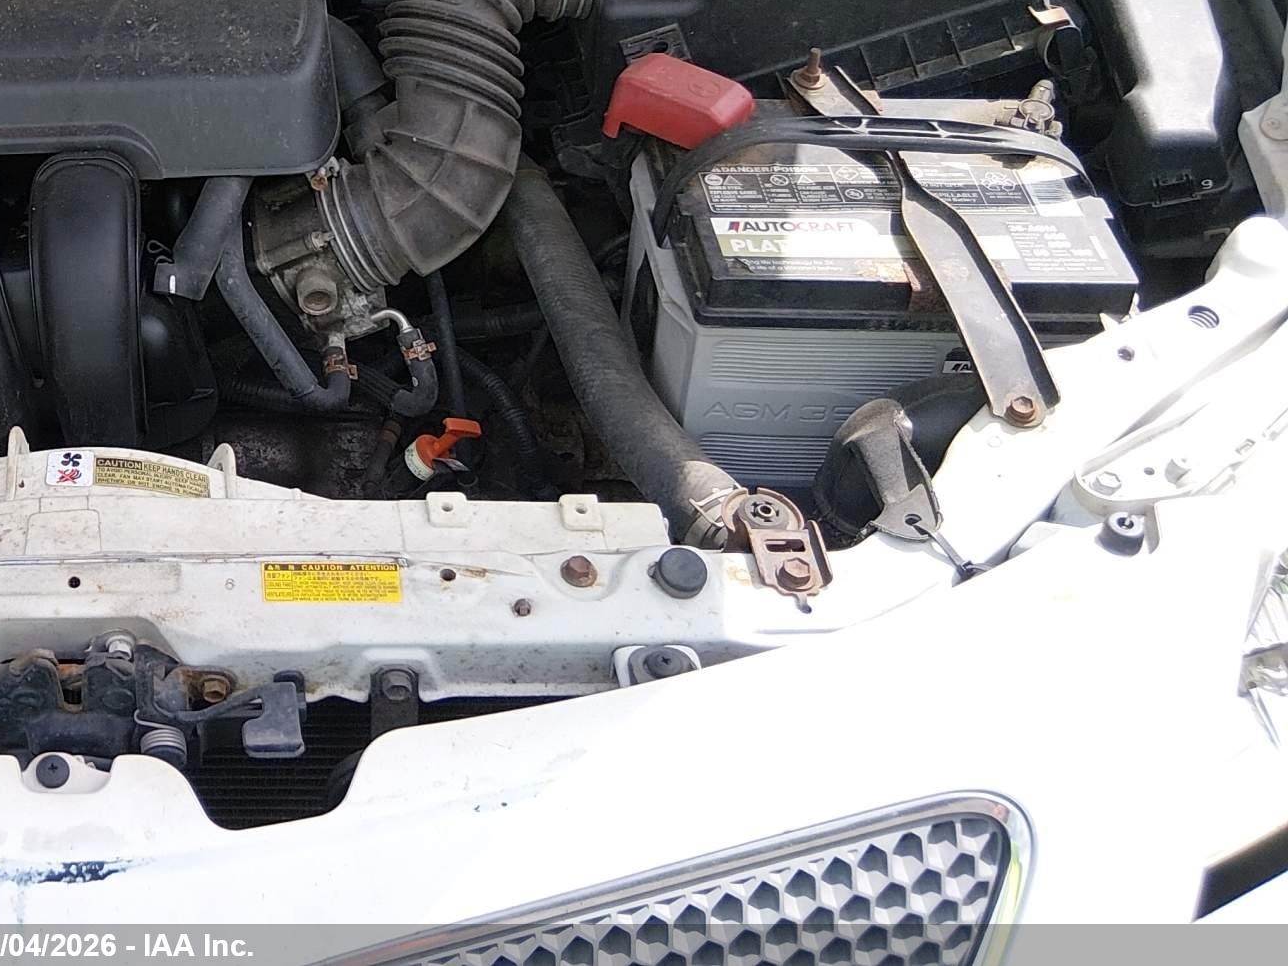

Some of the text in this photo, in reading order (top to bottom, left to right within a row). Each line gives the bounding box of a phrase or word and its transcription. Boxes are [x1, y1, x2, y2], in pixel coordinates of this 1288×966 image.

[742, 221, 854, 232] AUTOCRAFT
[703, 401, 792, 421] AGM
[97, 459, 142, 469] CAUTION
[143, 463, 161, 472] KEEP
[162, 465, 185, 476] HANDS
